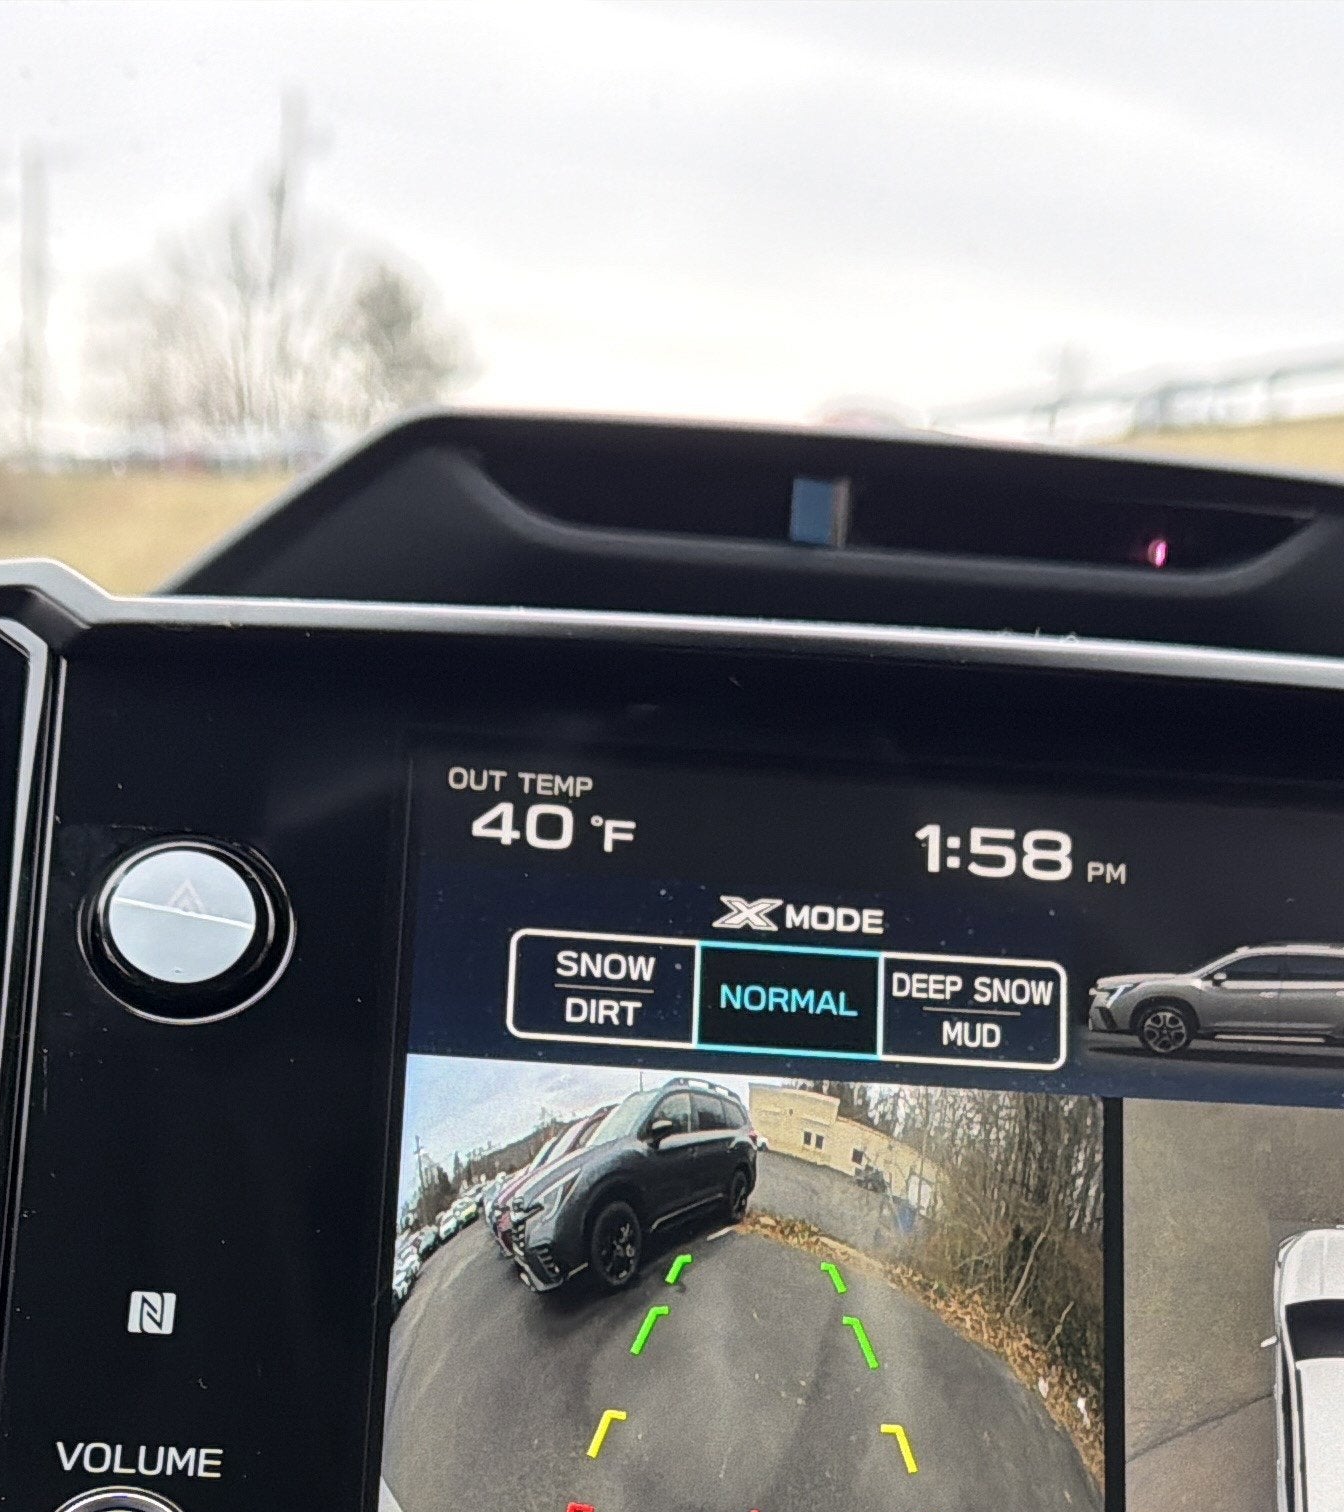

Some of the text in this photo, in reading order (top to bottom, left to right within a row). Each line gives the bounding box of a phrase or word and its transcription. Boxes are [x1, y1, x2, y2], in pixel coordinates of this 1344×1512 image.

[449, 767, 592, 797] OUT TEMP
[472, 803, 573, 849] 40
[916, 825, 1126, 884] 1:58 PM
[786, 905, 883, 934] MODE
[557, 951, 655, 981] SNOW
[721, 985, 858, 1016] NORMAL
[893, 972, 1053, 1005] DEEP SNOW
[566, 998, 642, 1026] DIRT
[943, 1021, 1000, 1047] MUD
[57, 1442, 223, 1477] VOLUME
